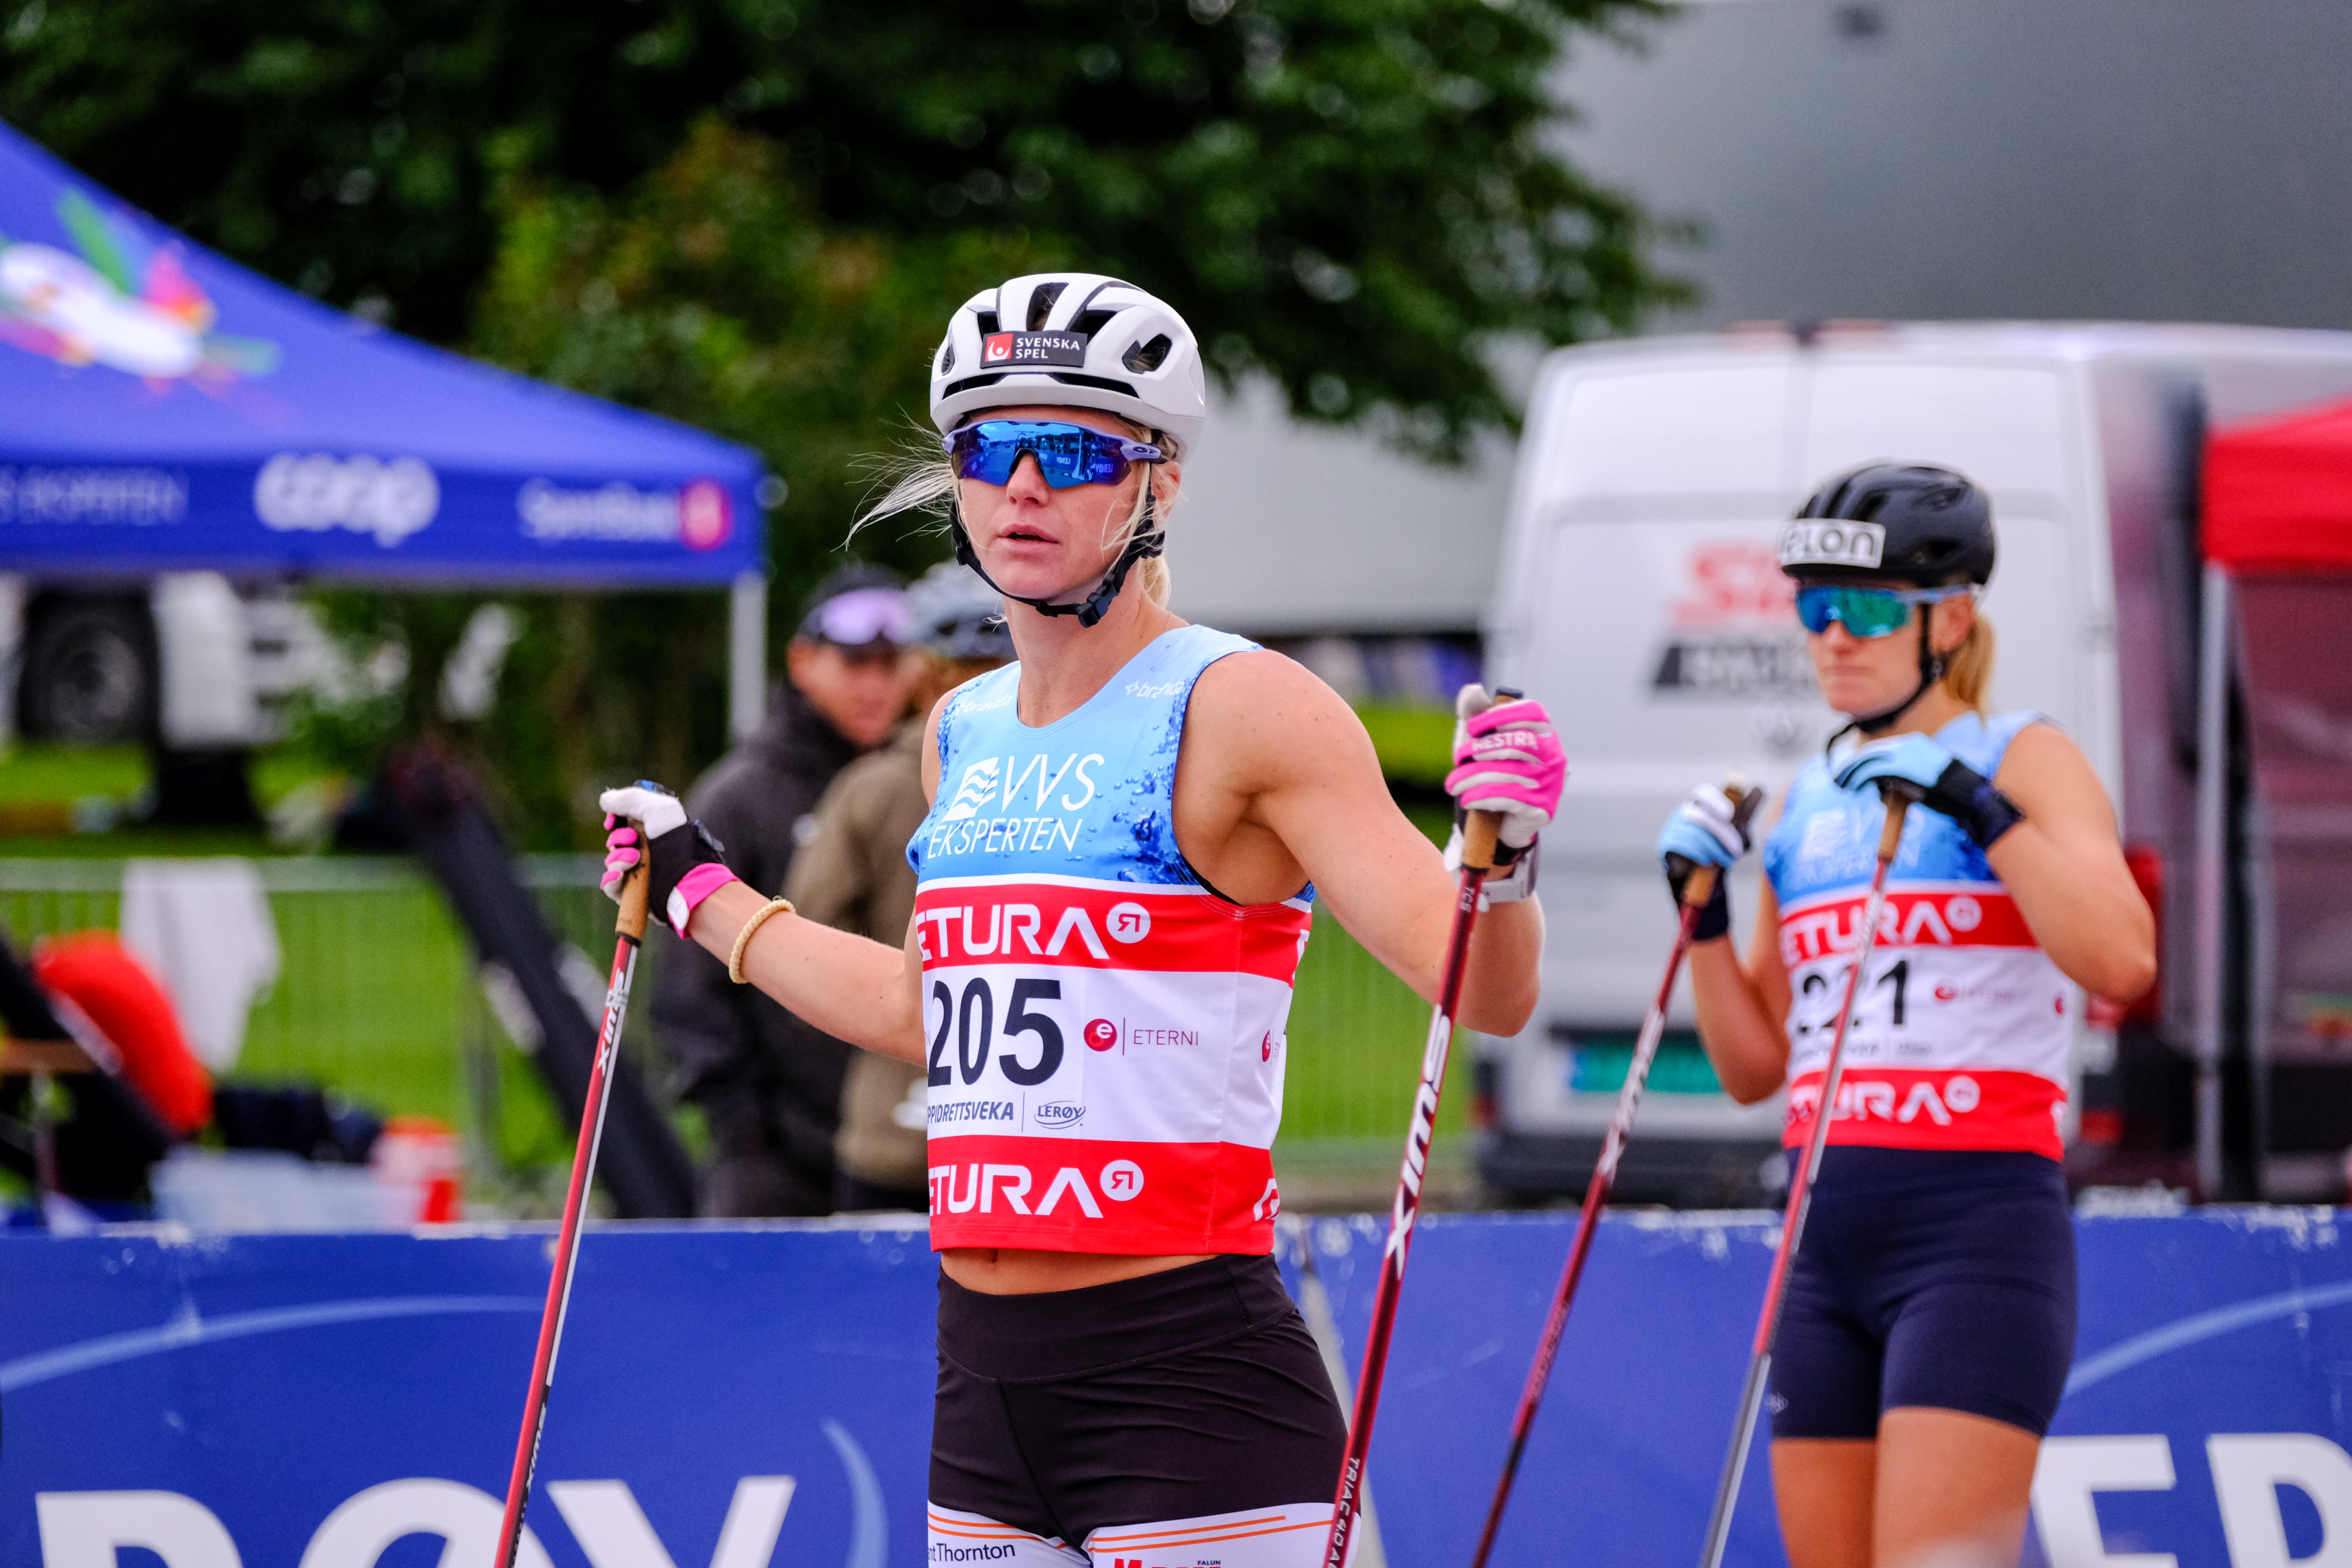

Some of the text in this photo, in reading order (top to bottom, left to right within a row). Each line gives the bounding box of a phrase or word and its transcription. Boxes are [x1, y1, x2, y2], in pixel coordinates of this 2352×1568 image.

[1015, 348, 1048, 359] SPEL
[1016, 337, 1080, 351] SVENSKA
[1001, 753, 1105, 814] VVS
[927, 817, 1083, 860] EKSPERTEN
[928, 977, 1064, 1087] 205
[1133, 1029, 1199, 1047] ETERNI
[1038, 1104, 1085, 1118] LERØY
[1339, 1457, 1361, 1516] TRIAC
[936, 1543, 1016, 1562] Thornton
